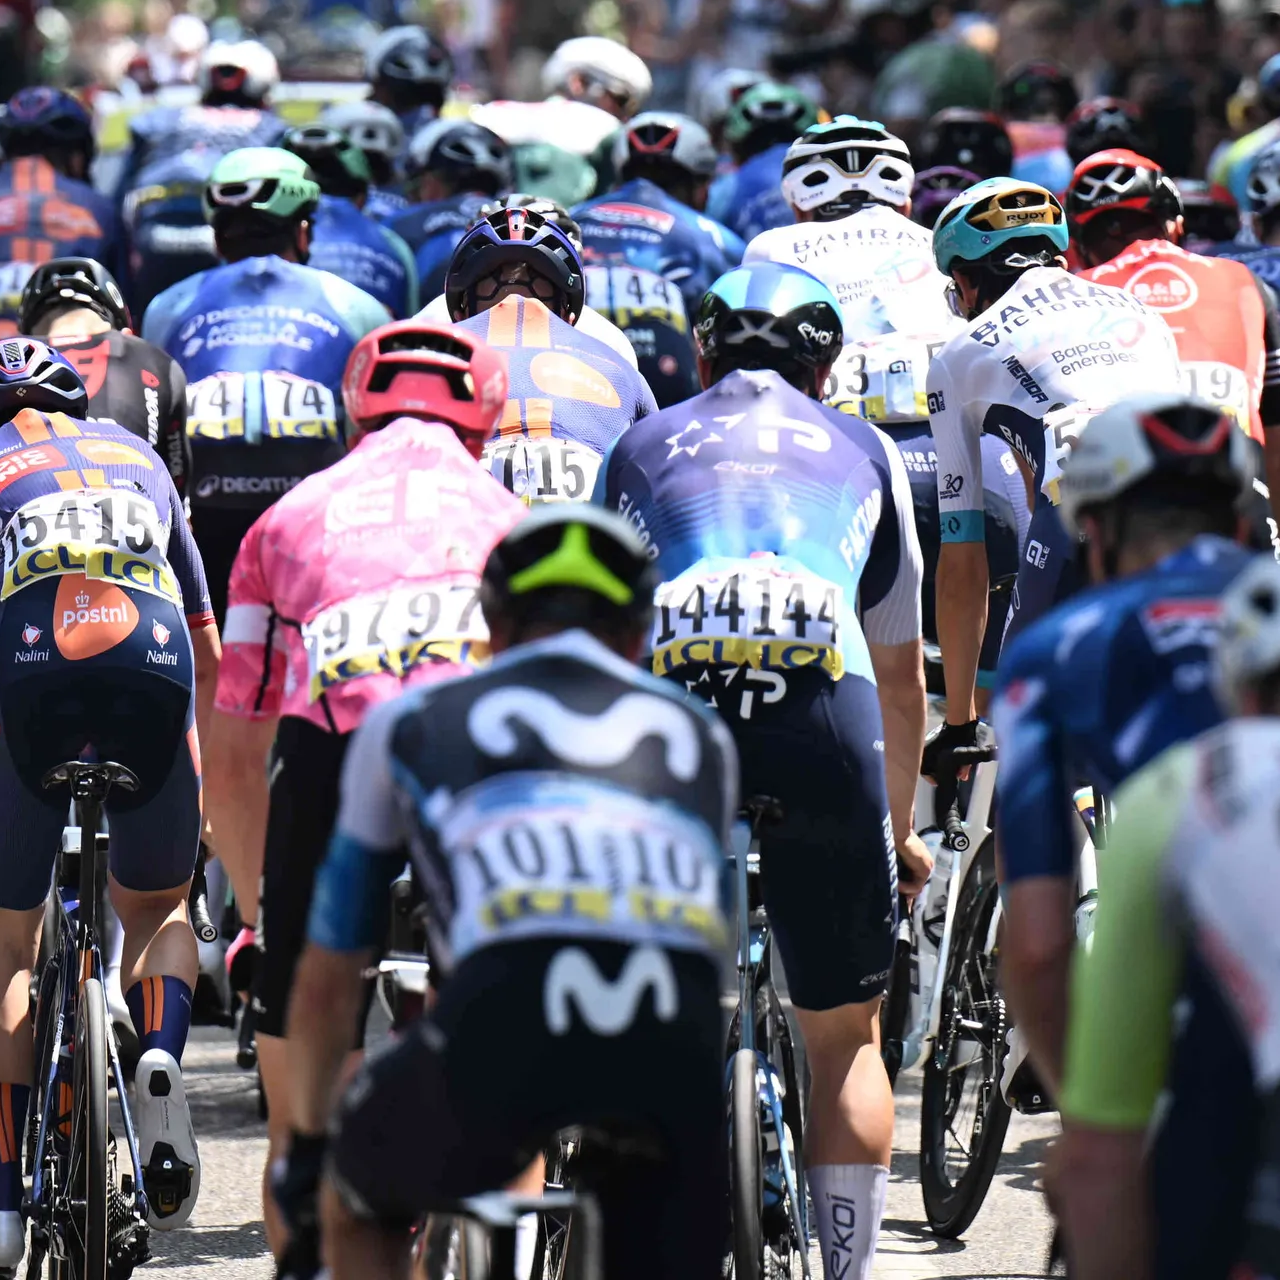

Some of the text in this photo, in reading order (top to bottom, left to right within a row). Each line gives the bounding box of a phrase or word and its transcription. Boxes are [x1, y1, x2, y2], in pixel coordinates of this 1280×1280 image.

[1006, 211, 1047, 222] RUDY
[1052, 340, 1112, 366] Bapco
[280, 379, 325, 417] 74
[7, 499, 87, 567] 154
[12, 545, 87, 587] LCL
[102, 551, 174, 599] LCL
[62, 603, 128, 630] postnl
[406, 585, 481, 638] 97
[656, 571, 746, 646] 144
[751, 577, 838, 645] 144
[14, 648, 50, 664] Nalini
[146, 649, 178, 666] Nalini
[473, 820, 590, 891] 101
